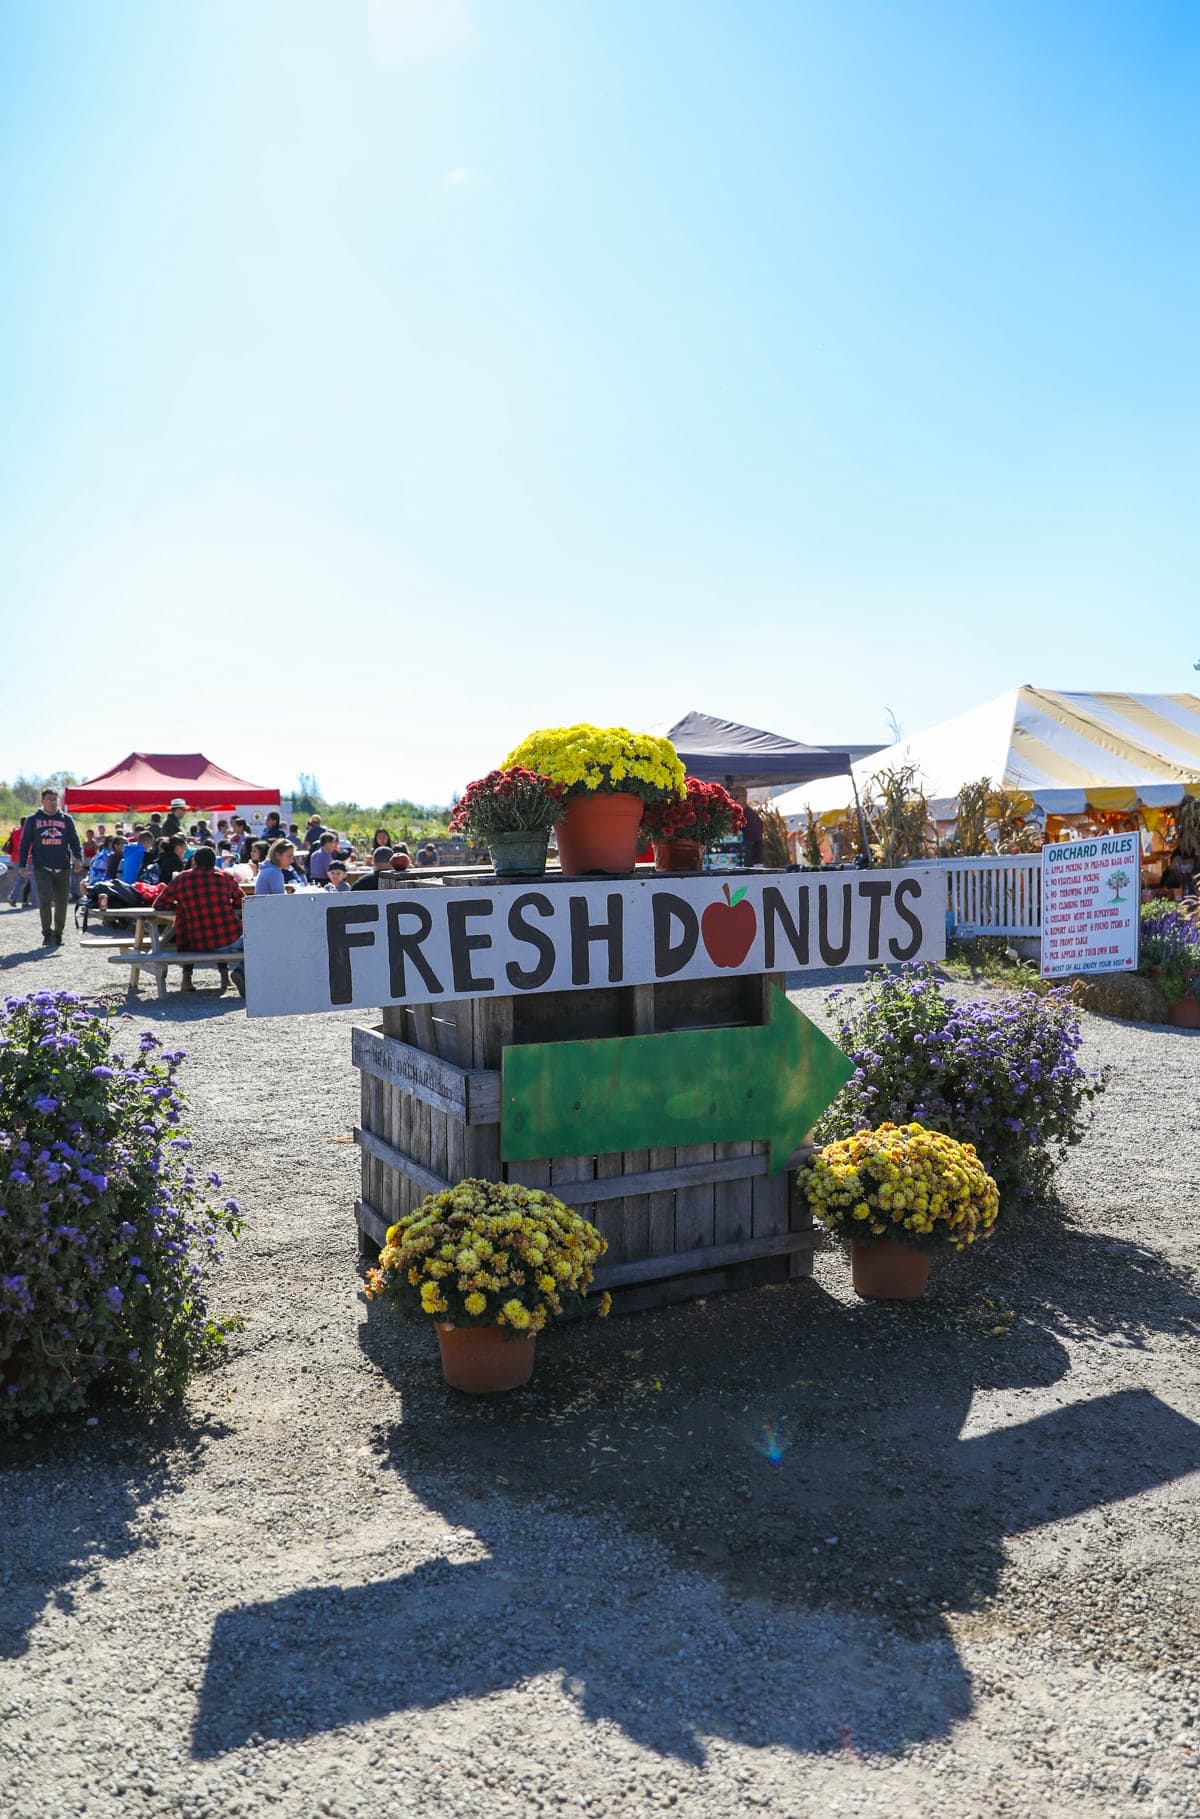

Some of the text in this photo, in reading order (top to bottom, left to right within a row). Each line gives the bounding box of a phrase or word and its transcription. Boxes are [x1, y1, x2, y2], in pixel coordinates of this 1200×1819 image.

[1049, 839, 1132, 862] ORCHARD RULES
[1051, 864, 1064, 874] APPLE
[1066, 863, 1082, 872] PICKING
[1058, 876, 1080, 885] VEGETABLE
[1083, 873, 1100, 882] PICKING
[1084, 886, 1099, 895] APPLES
[1050, 926, 1066, 935] REPORT
[1125, 919, 1130, 927] AT
[1060, 938, 1073, 946] FRONT
[1075, 936, 1088, 945] TABLE
[327, 892, 624, 1006] FRESH
[1062, 950, 1076, 958] APPLES
